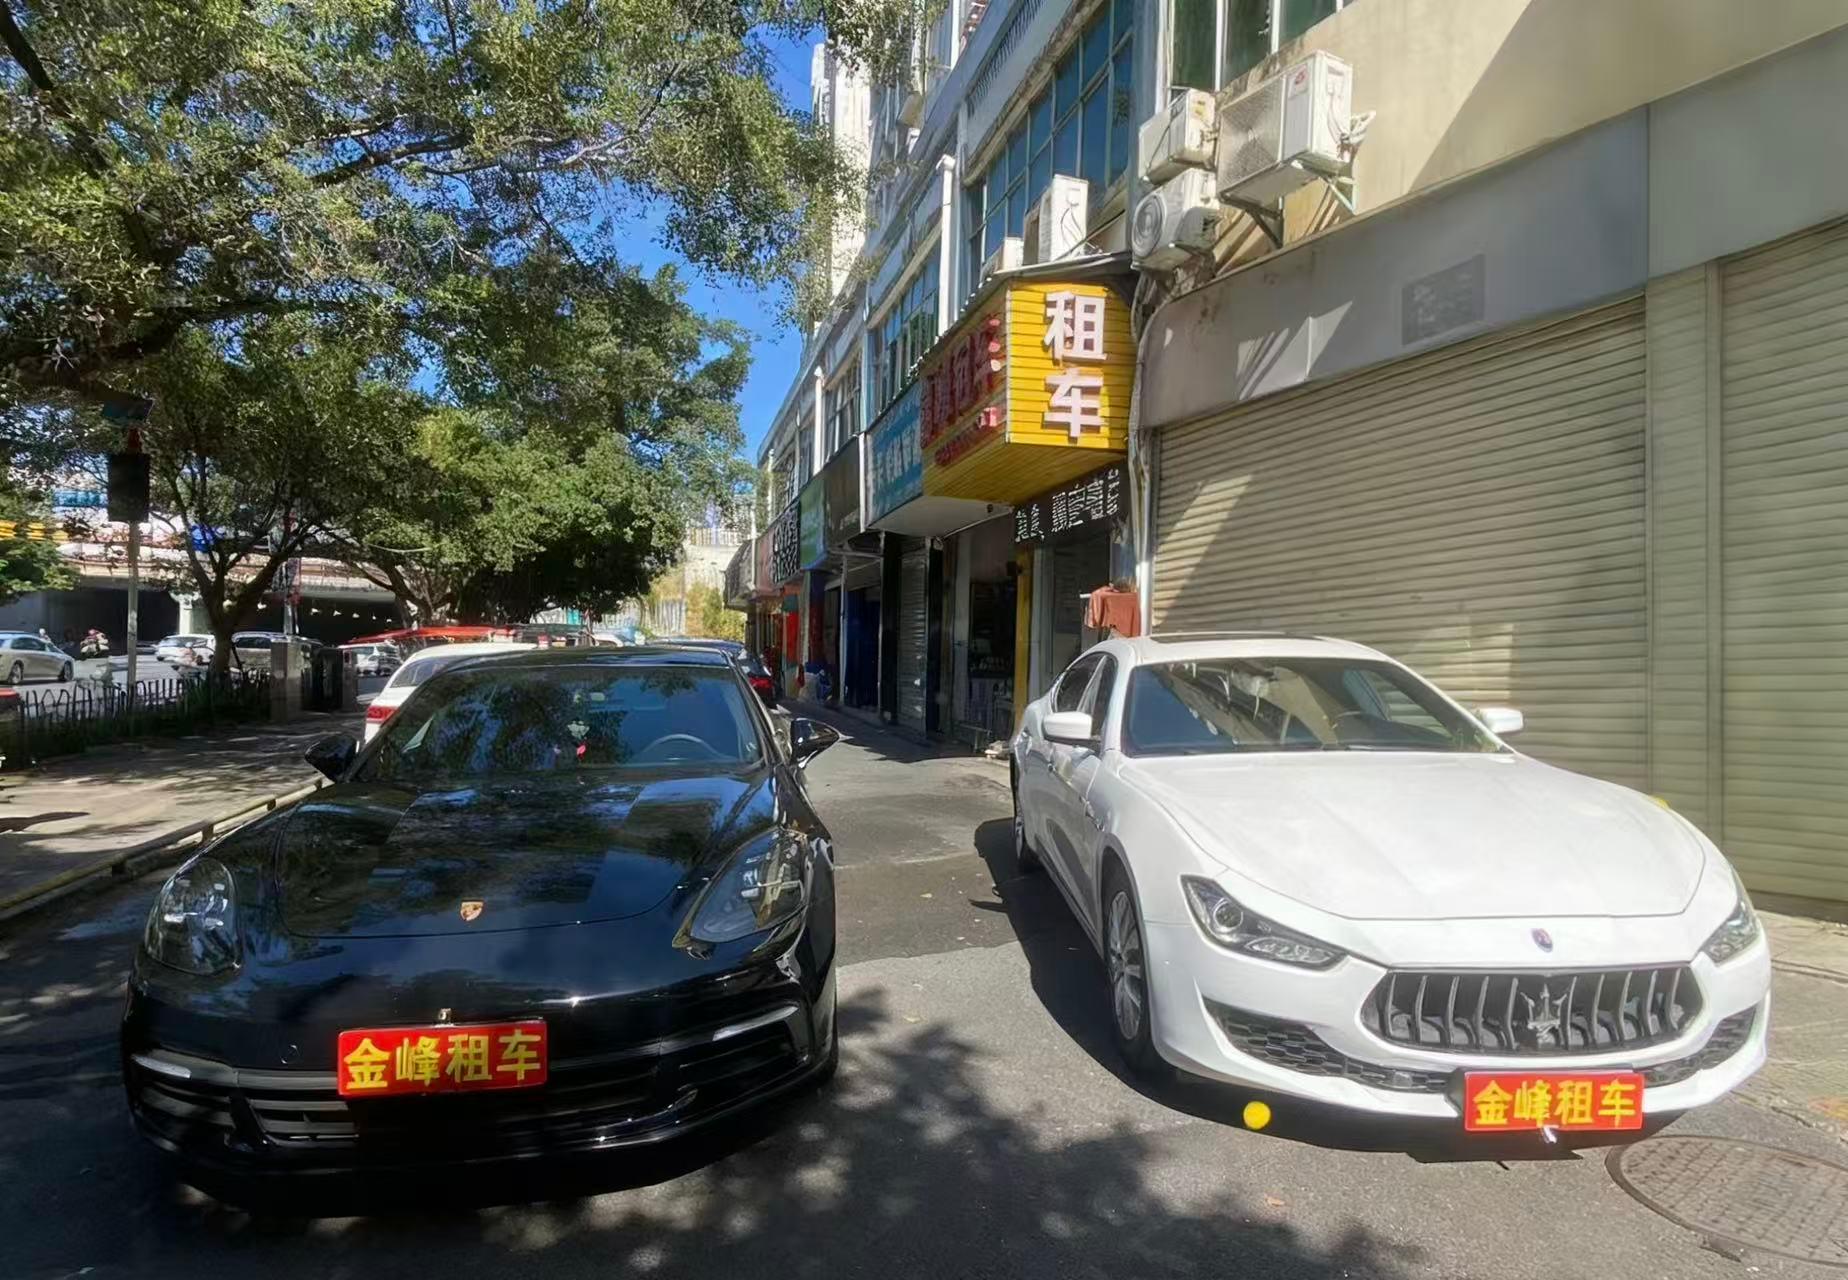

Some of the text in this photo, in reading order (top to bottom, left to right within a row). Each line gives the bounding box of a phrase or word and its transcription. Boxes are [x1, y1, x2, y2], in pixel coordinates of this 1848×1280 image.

[1043, 290, 1108, 438] 租车
[343, 1029, 542, 1090] 金峰租车
[1473, 1079, 1636, 1127] 金峰租车
